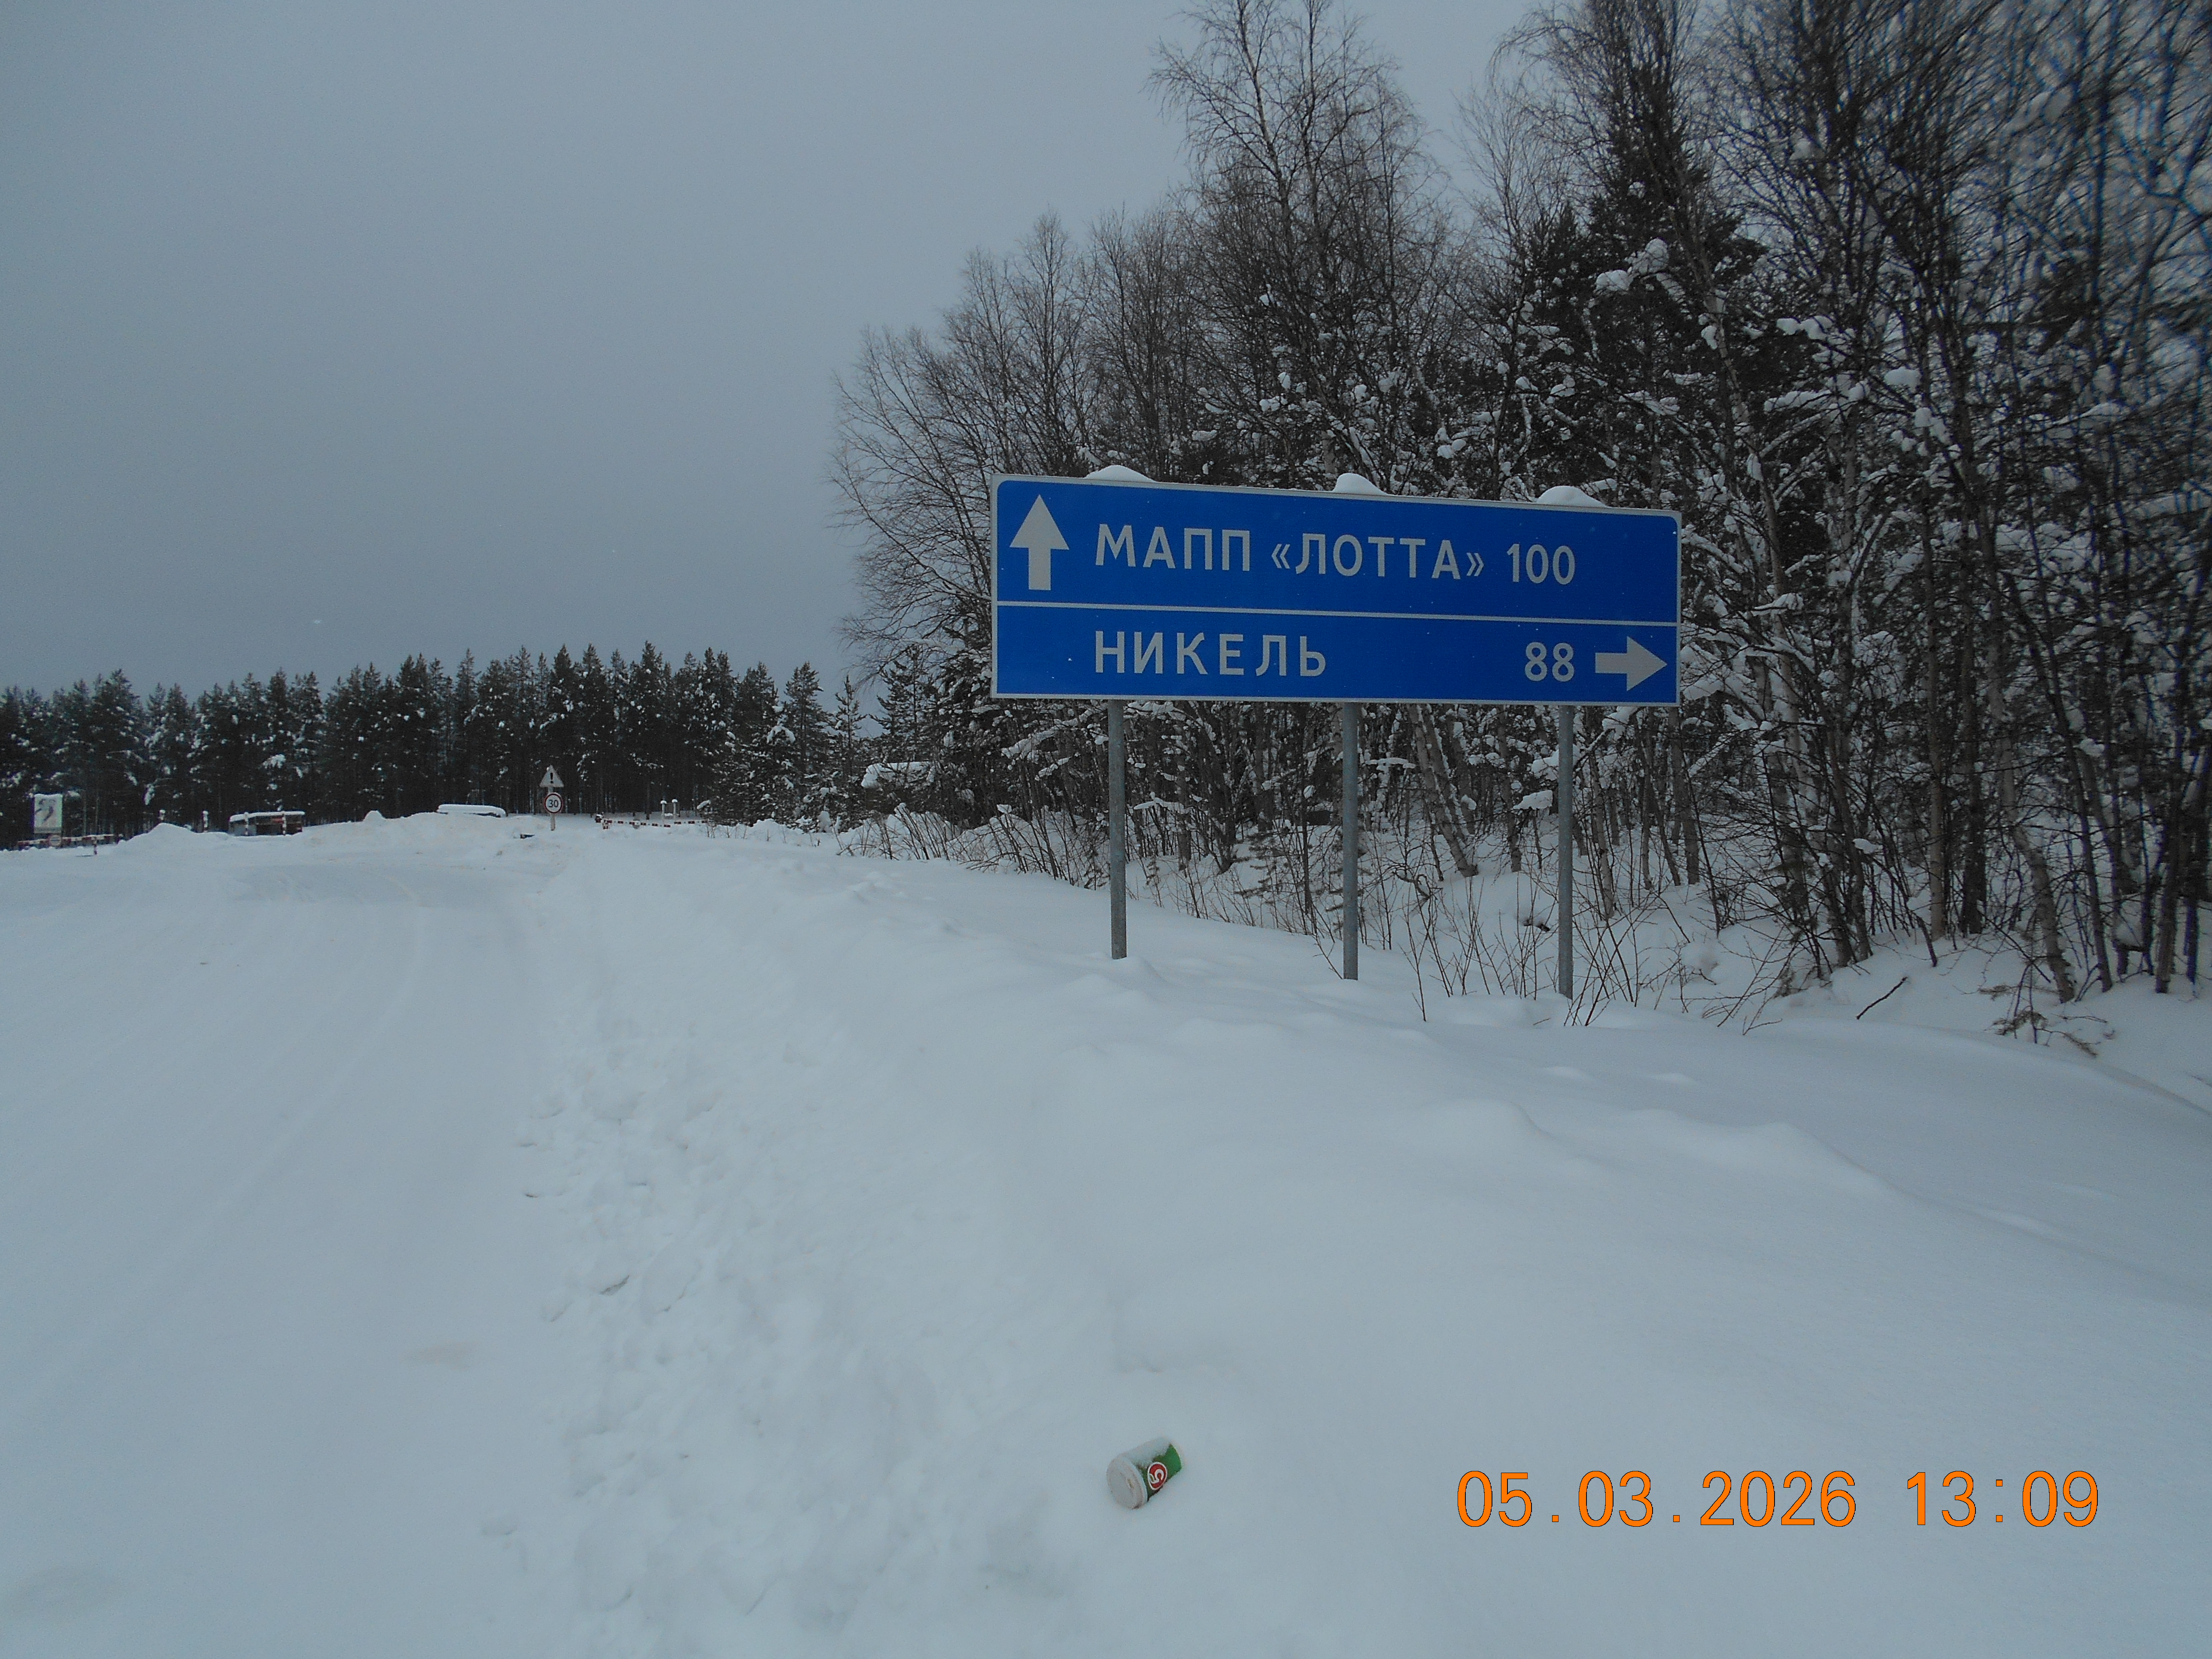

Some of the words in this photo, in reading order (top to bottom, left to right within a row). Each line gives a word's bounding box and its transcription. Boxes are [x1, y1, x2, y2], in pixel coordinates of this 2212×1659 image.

[1096, 523, 1250, 571] МАПП
[1271, 533, 1485, 580] «ЛОТТА»
[1506, 543, 1576, 585] 100
[1096, 630, 1326, 676] НИКЕЛЬ
[1524, 641, 1574, 682] 88
[549, 799, 559, 808] 30
